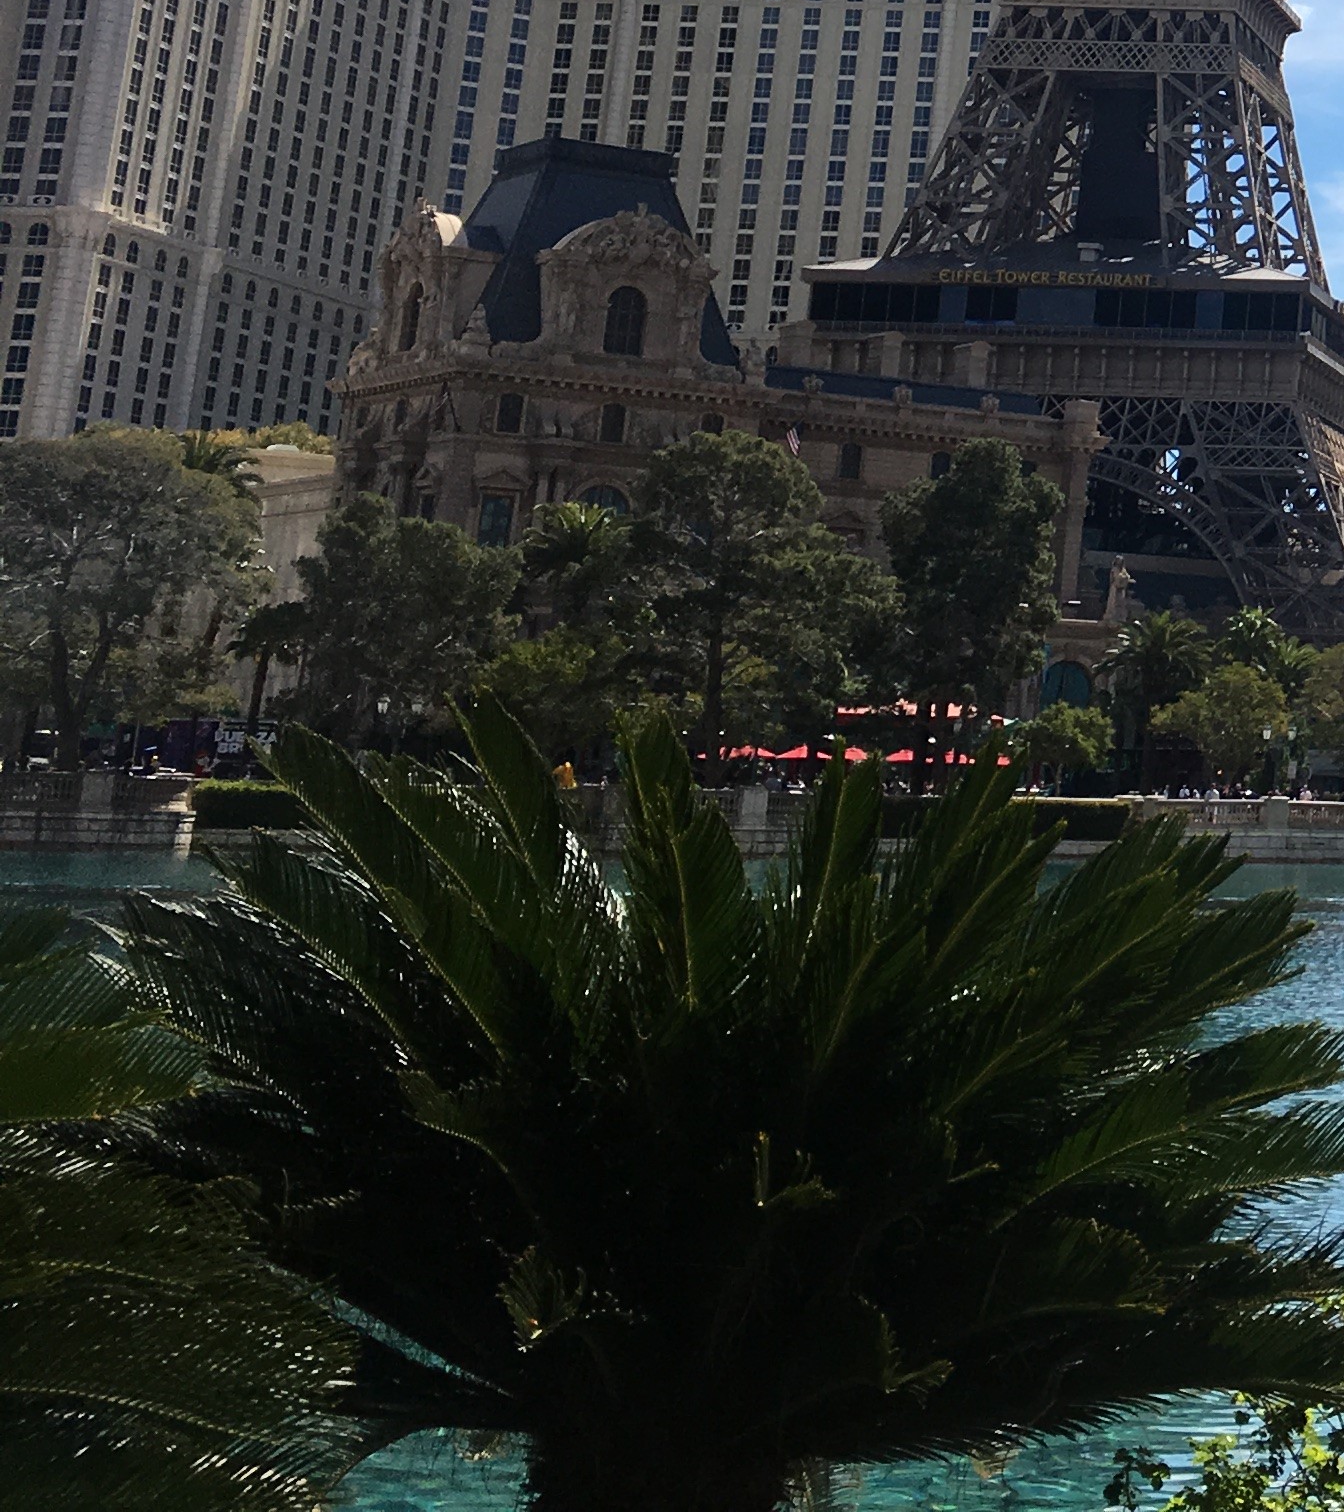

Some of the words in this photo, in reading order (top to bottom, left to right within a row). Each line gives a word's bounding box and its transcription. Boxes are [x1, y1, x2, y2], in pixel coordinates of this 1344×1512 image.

[938, 268, 991, 284] EIFFEL
[996, 269, 1050, 284] TOWER
[1057, 270, 1153, 287] RESTAURANT
